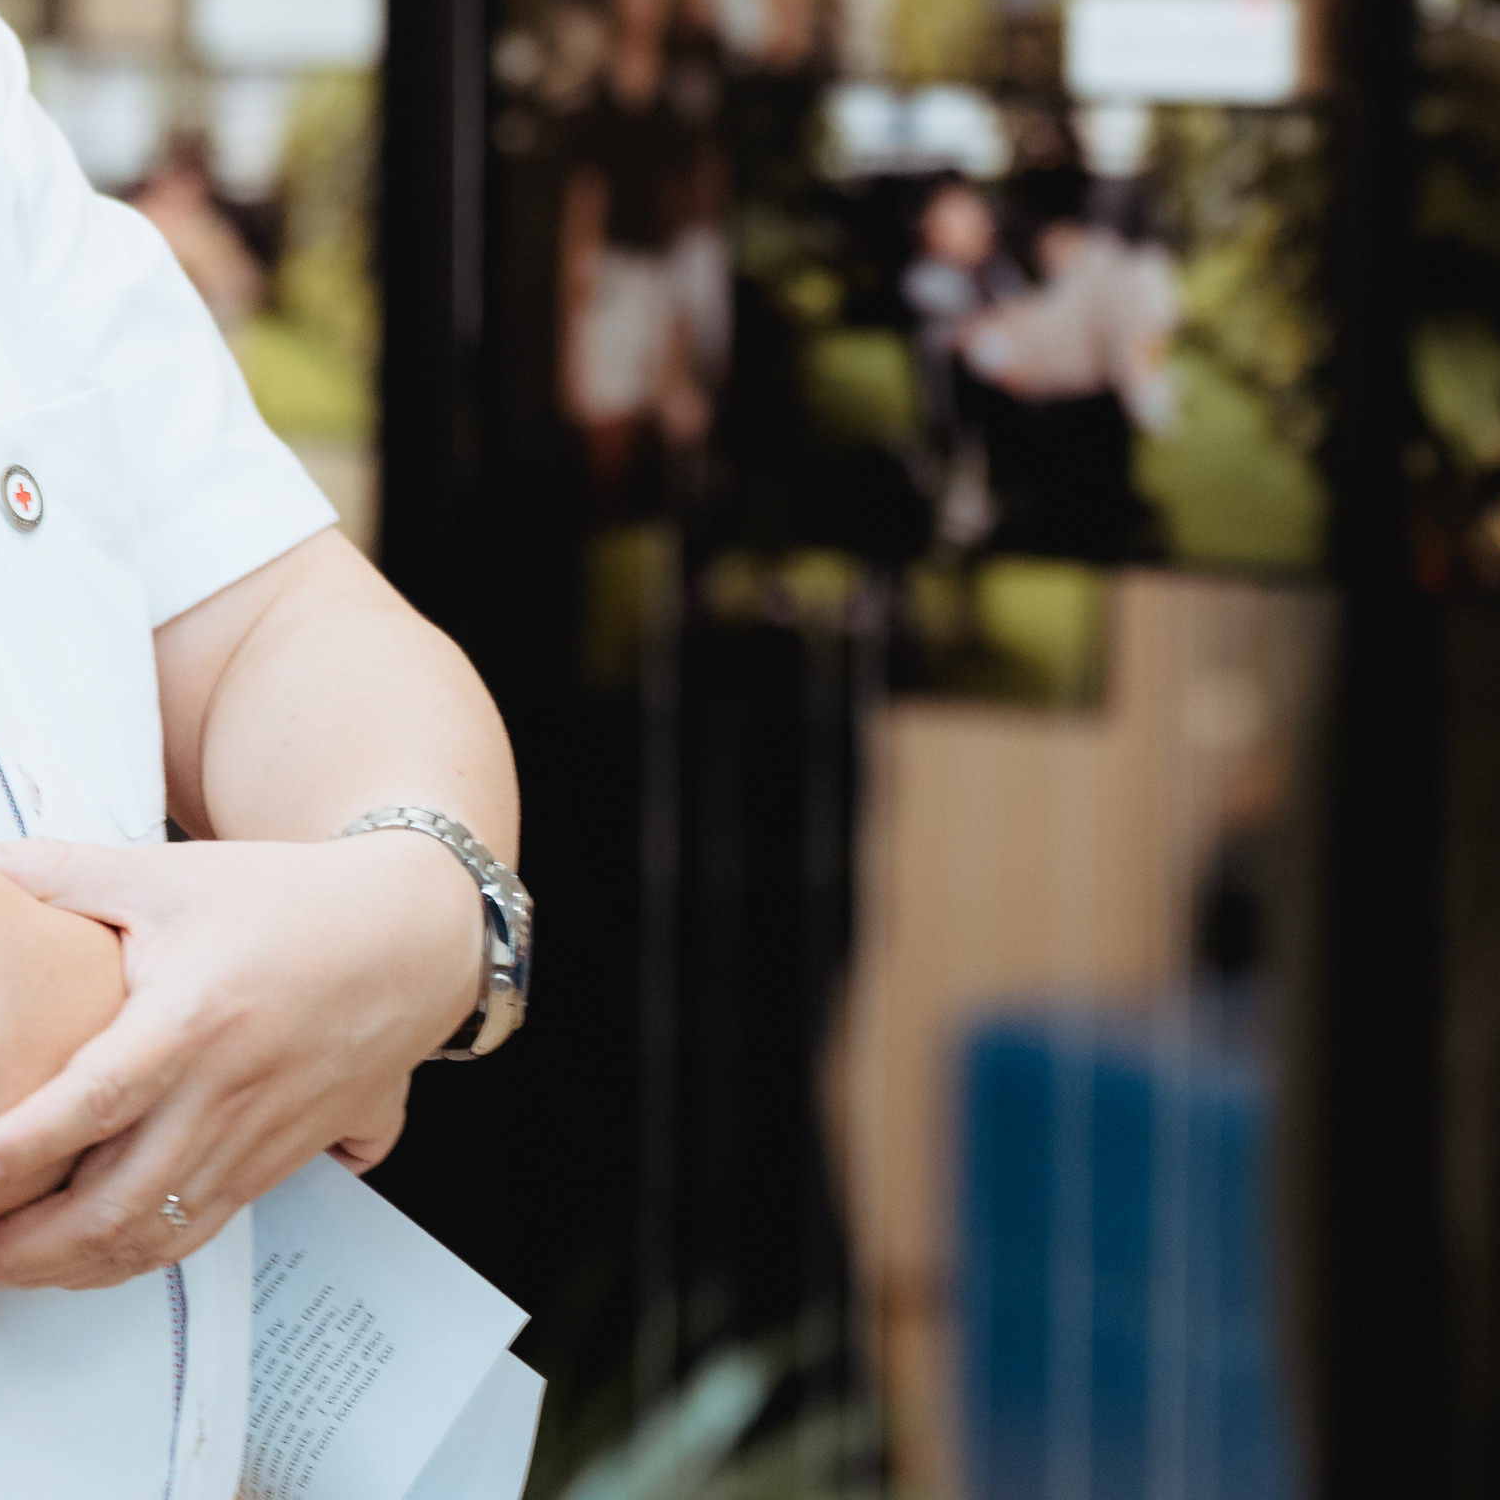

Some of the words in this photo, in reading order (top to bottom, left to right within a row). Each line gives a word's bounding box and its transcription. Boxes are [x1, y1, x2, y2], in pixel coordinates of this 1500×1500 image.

[251, 1271, 287, 1315] define
[261, 1357, 278, 1375] us
[276, 1322, 303, 1356] give
[299, 1283, 336, 1322] them
[265, 1317, 285, 1338] by
[248, 1394, 275, 1429] than
[269, 1362, 295, 1392] just
[250, 1399, 294, 1486] unwavering
[288, 1340, 337, 1396] support.
[334, 1296, 365, 1333] They
[268, 1446, 285, 1479] and
[280, 1422, 298, 1445] we
[295, 1394, 315, 1420] are
[313, 1375, 331, 1392] so
[326, 1311, 377, 1372] honored
[308, 1424, 338, 1462] from
[332, 1367, 379, 1422] fotohub
[375, 1340, 397, 1365] for
[324, 1361, 363, 1405] would
[359, 1330, 384, 1361] also
